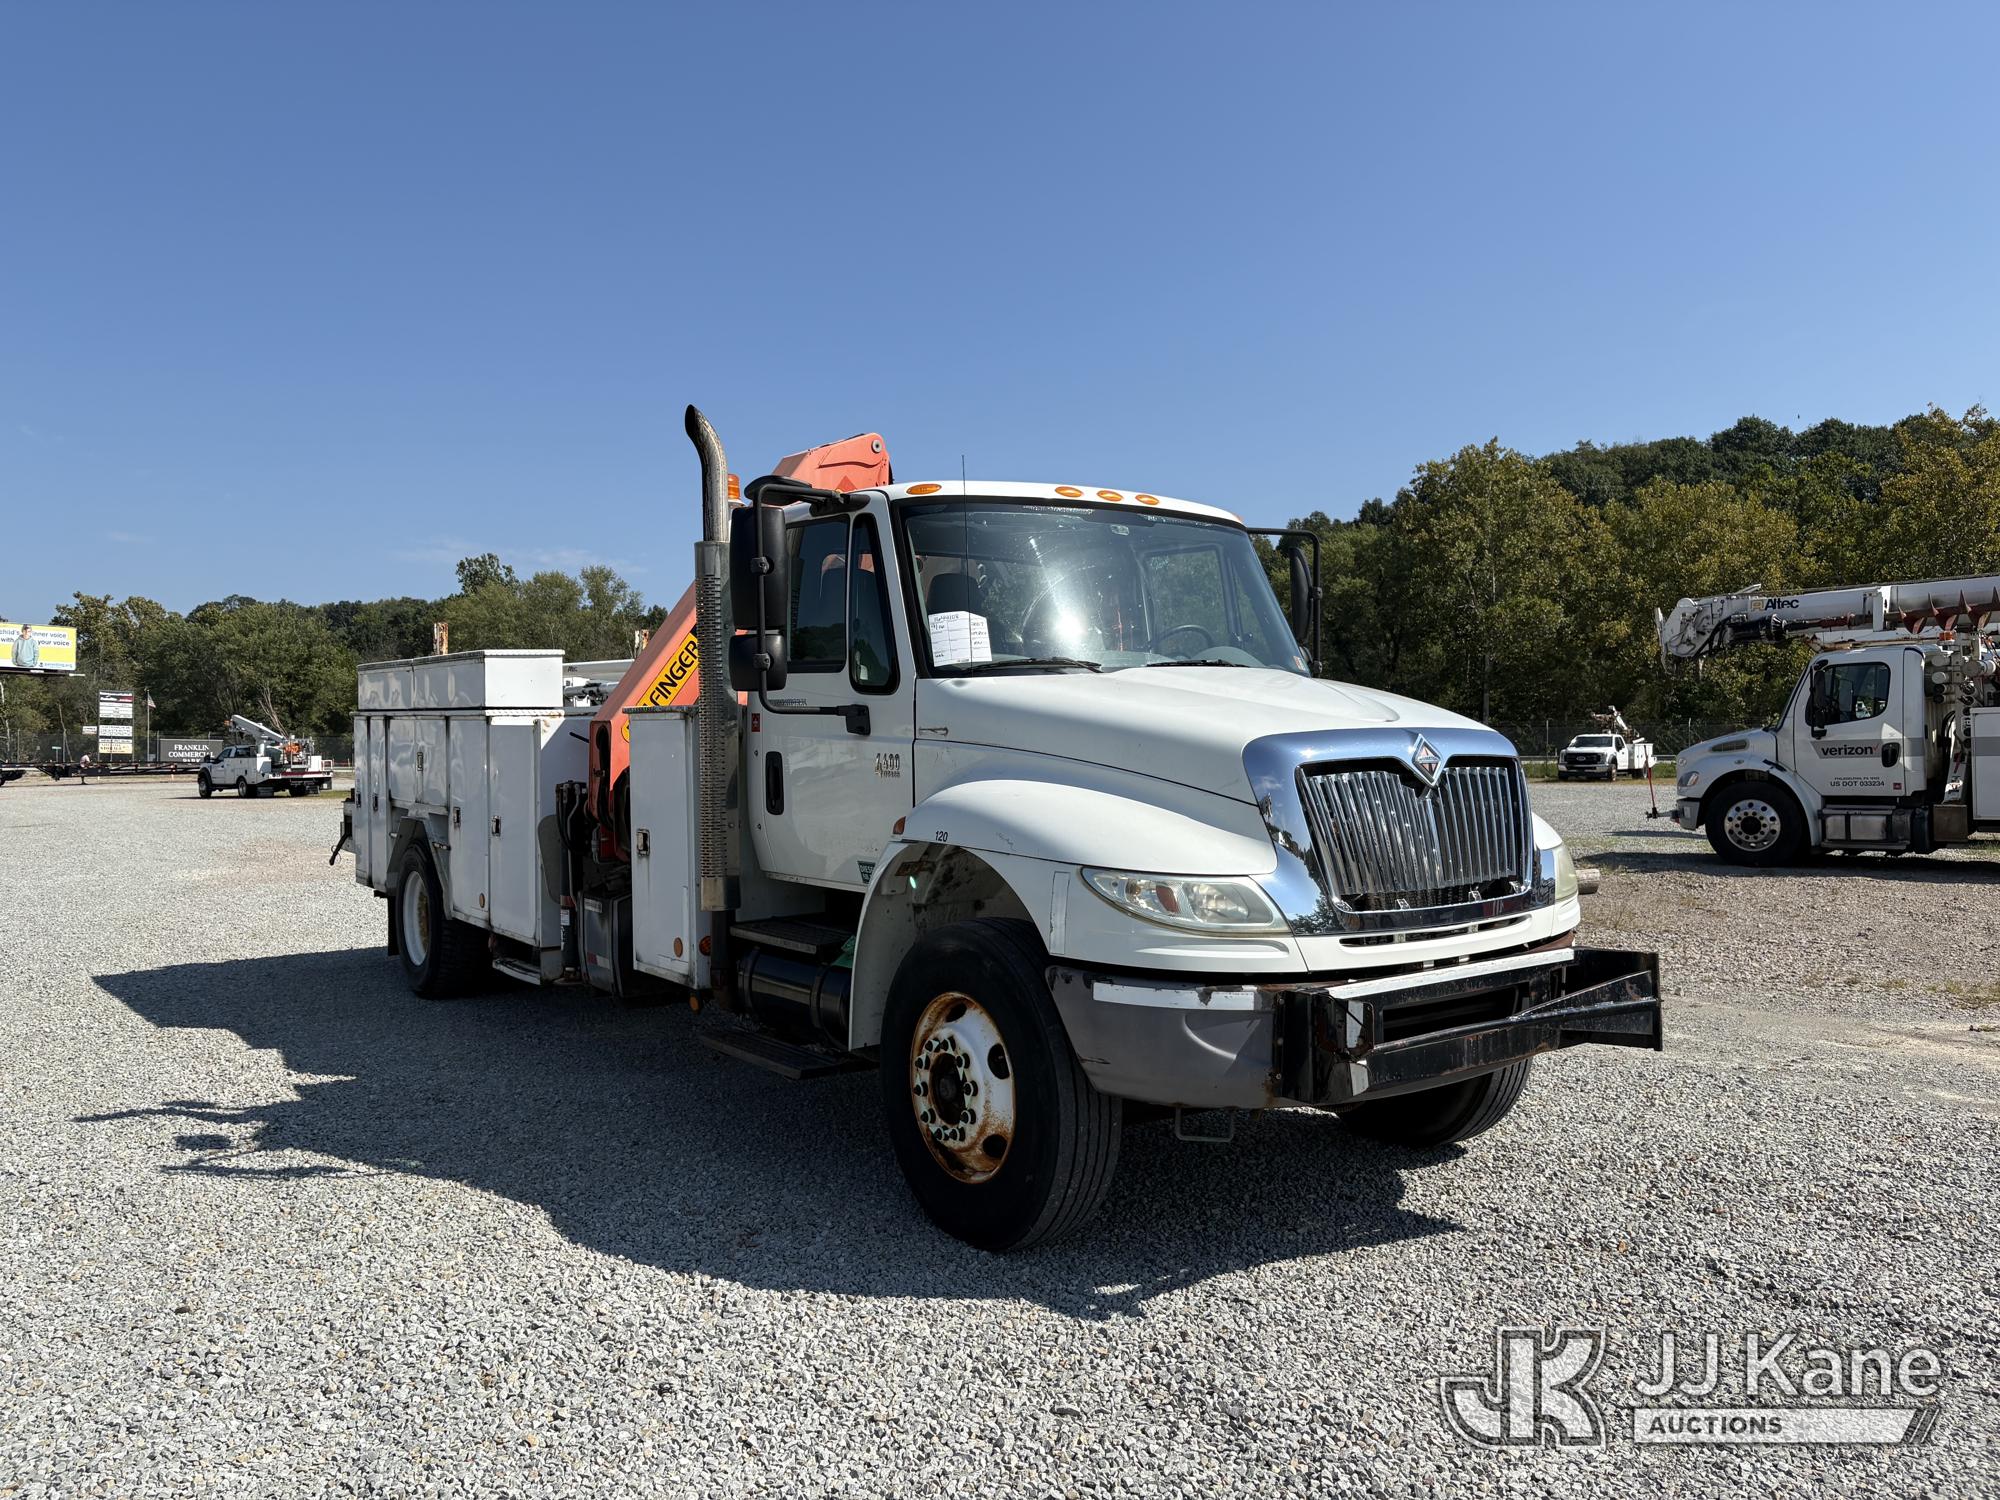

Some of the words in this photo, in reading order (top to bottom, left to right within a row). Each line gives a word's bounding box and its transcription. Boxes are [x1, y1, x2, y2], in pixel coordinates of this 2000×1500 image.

[1764, 598, 1800, 610] Altec
[1821, 744, 1874, 756] verizon
[935, 830, 949, 842] 120
